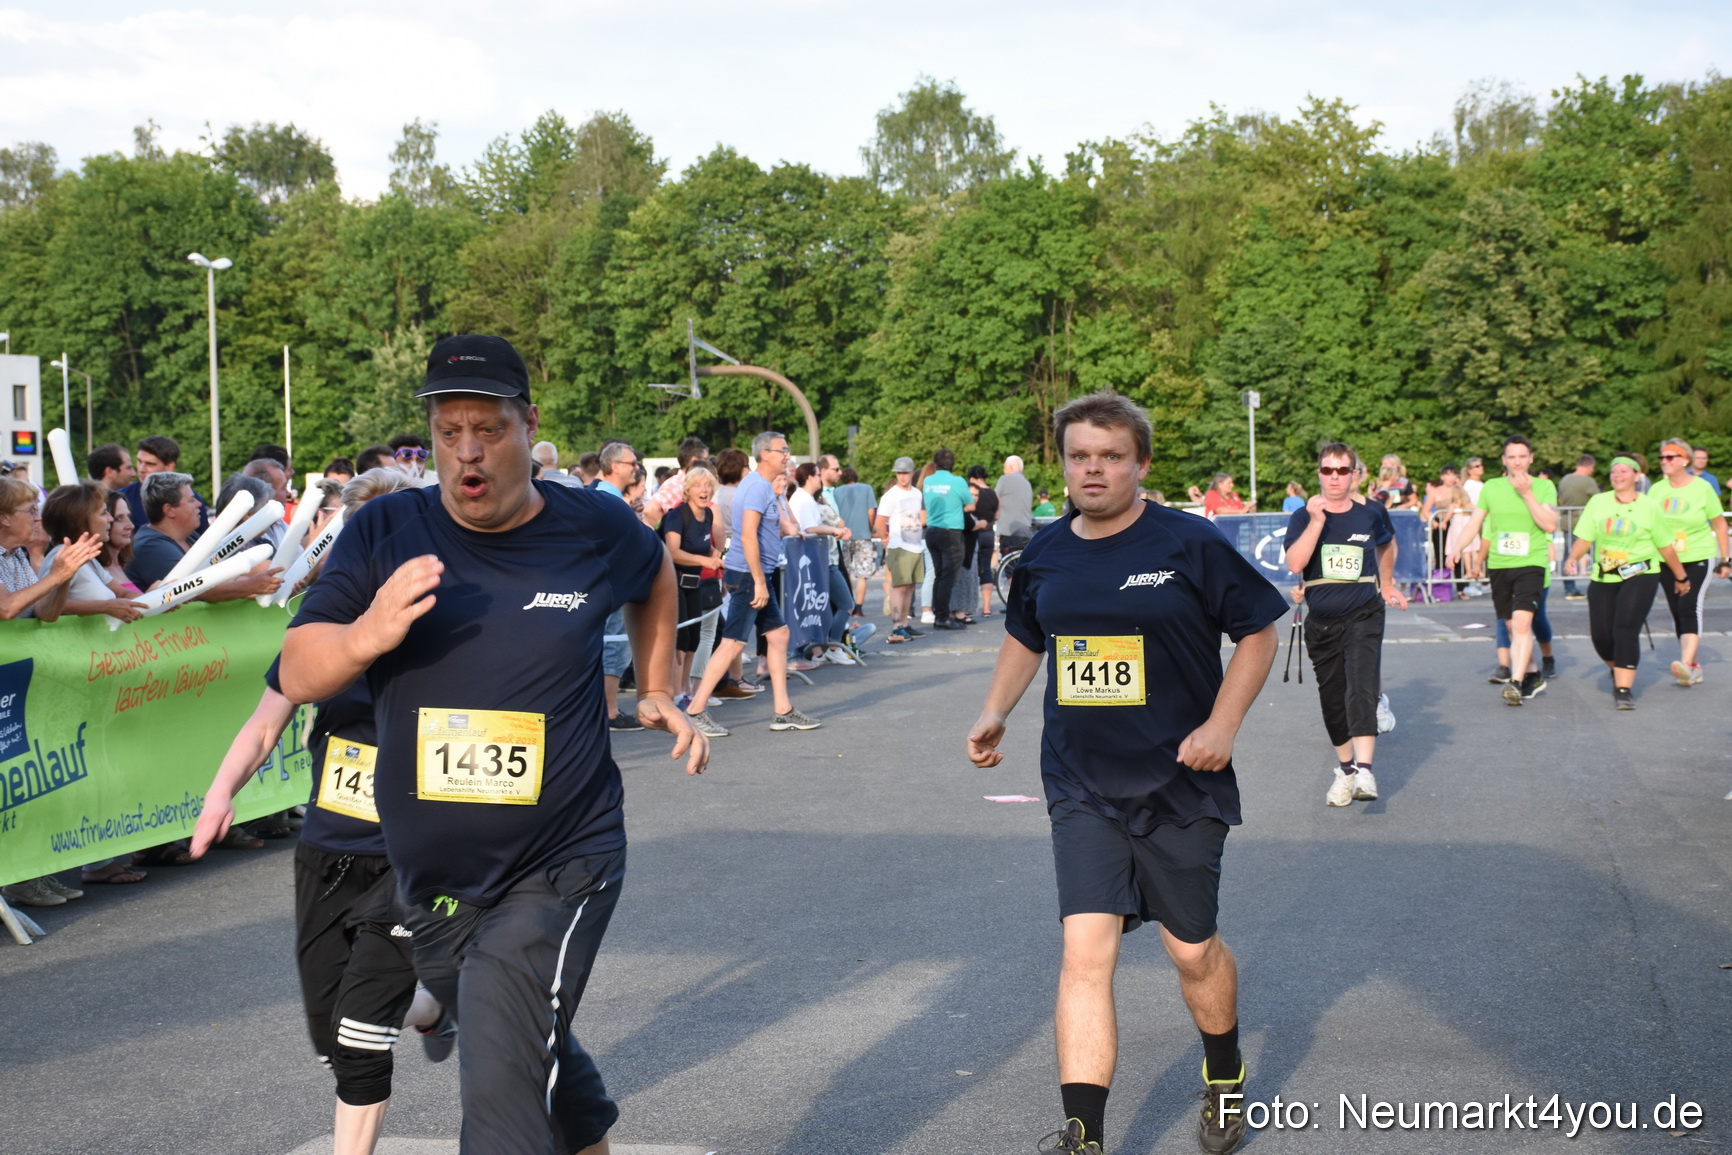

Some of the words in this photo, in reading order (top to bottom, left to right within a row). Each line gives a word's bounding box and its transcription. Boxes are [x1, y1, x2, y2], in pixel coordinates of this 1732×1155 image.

[1503, 540, 1521, 550] 453
[1327, 557, 1360, 571] 1455
[1119, 572, 1159, 590] JURA
[522, 592, 575, 610] JURA
[87, 631, 158, 682] Gesunde
[153, 625, 210, 657] Firmen
[114, 671, 170, 714] laufen
[172, 646, 230, 697] länger!
[1067, 661, 1131, 686] 1418
[435, 742, 527, 778] 1435
[447, 776, 482, 787] Reulein
[485, 778, 514, 788] Marco
